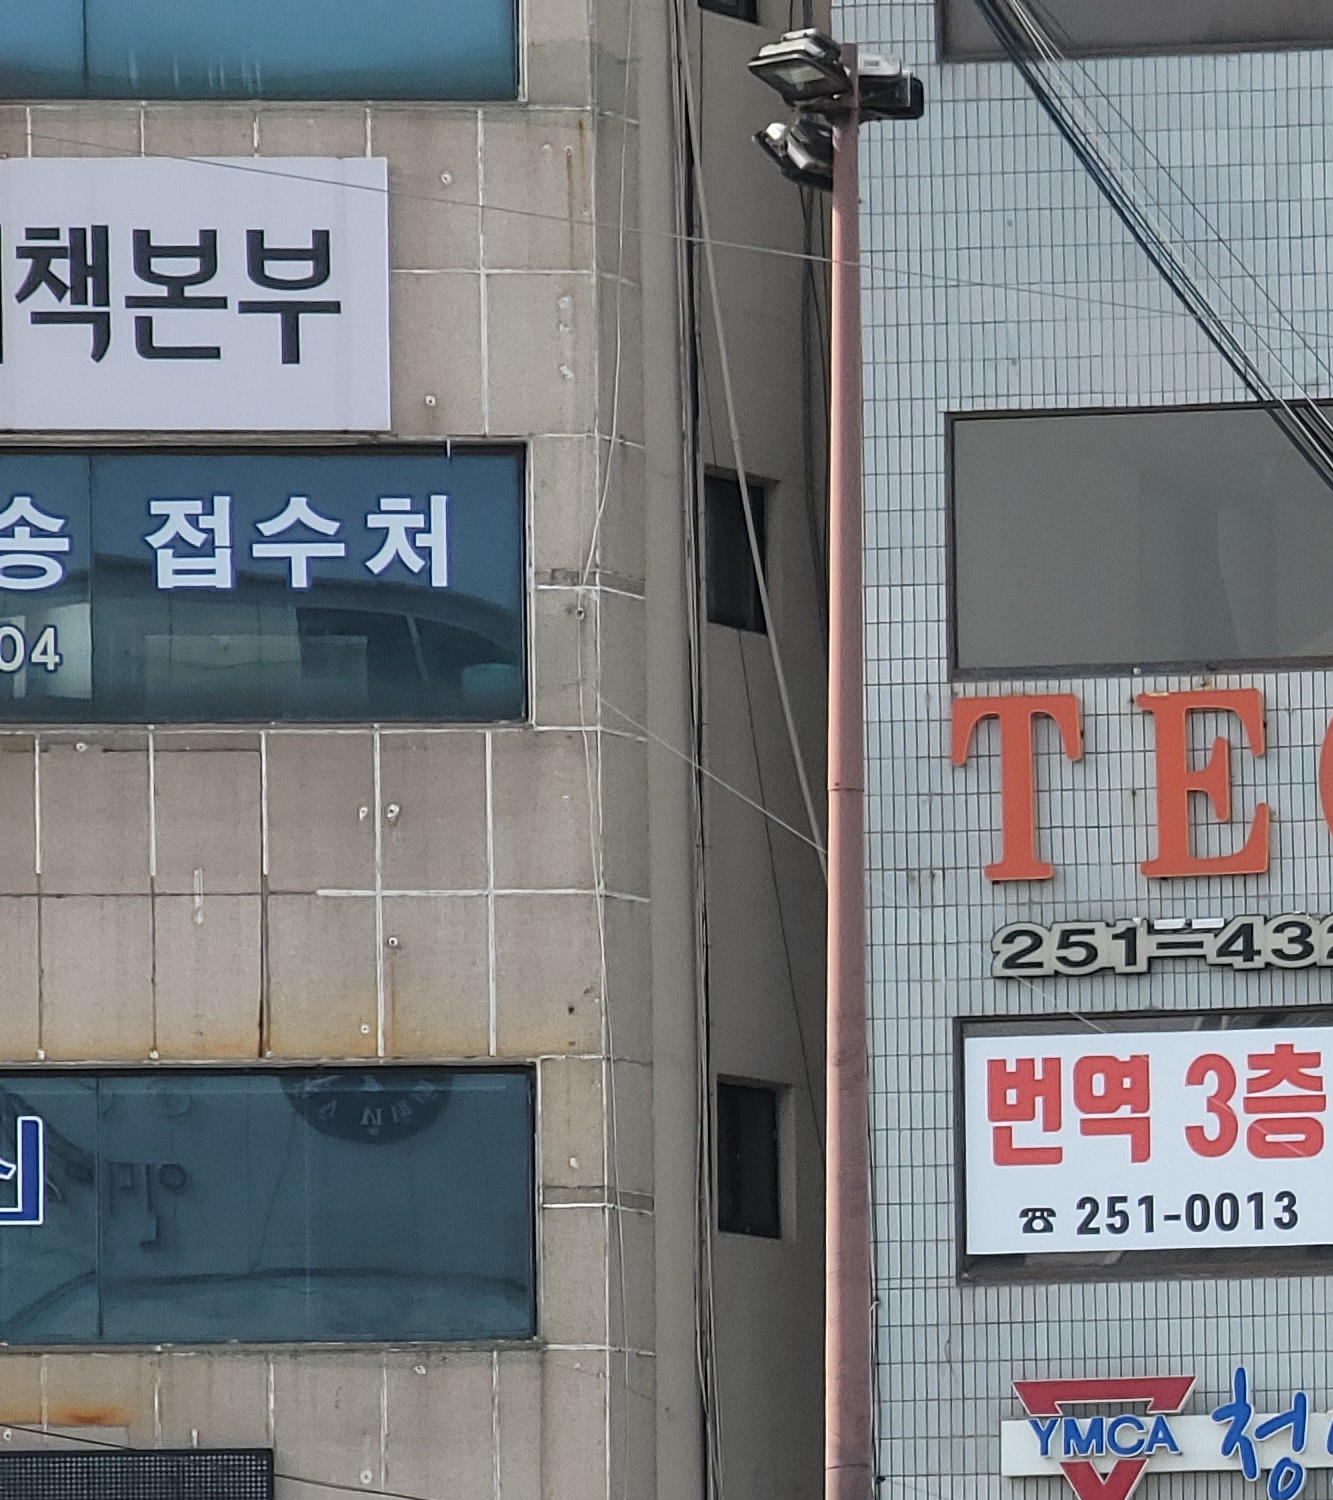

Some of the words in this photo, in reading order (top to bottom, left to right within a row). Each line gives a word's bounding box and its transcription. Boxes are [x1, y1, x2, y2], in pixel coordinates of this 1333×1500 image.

[0, 225, 341, 365] 책본부
[145, 494, 450, 589] 접수처
[986, 1053, 1151, 1167] 번역
[1184, 1043, 1327, 1160] 3층
[1075, 1190, 1299, 1237] 251-0013
[1026, 1414, 1181, 1459] YMCA
